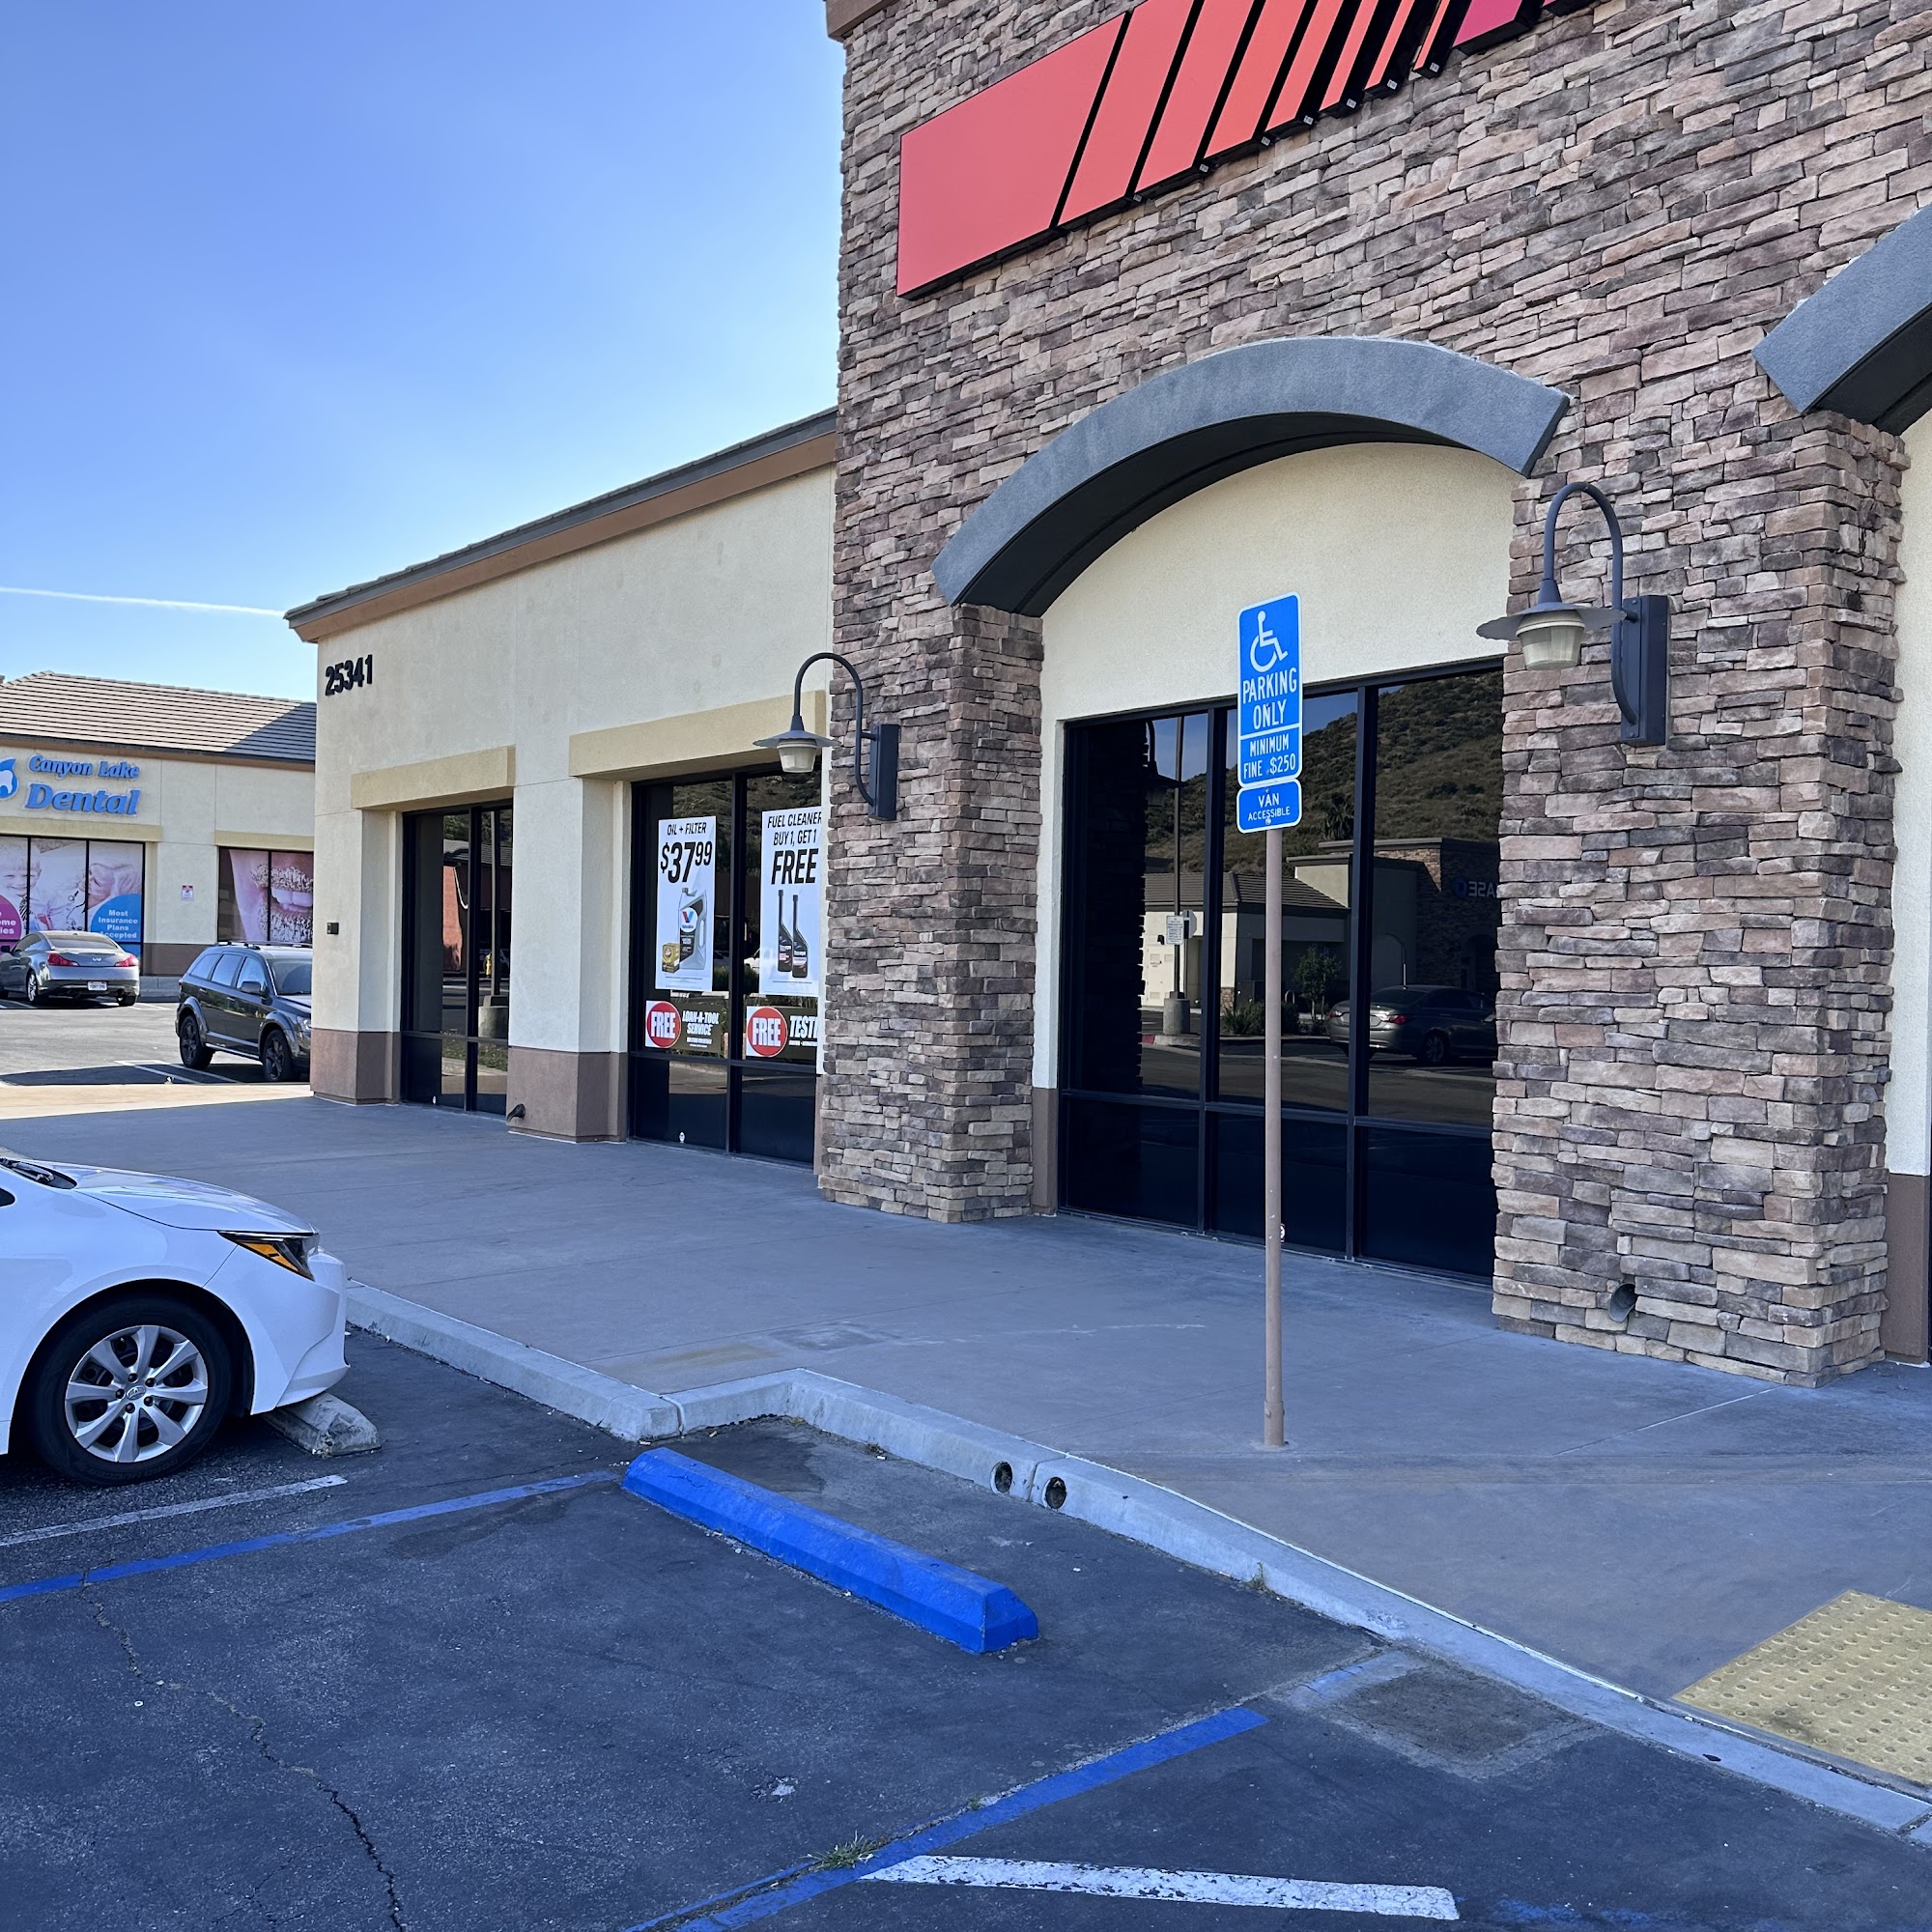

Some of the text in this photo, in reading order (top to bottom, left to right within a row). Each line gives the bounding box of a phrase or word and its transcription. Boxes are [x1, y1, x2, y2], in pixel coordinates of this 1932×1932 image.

[326, 654, 373, 696] 25341
[1242, 667, 1297, 704] PARKING
[1253, 698, 1287, 730] ONLY
[1249, 733, 1290, 757] MINIMUM
[28, 753, 141, 780] Canyon Lake
[1243, 753, 1296, 780] FINE $250
[24, 782, 140, 815] Dental
[1258, 792, 1280, 809] VAN
[767, 814, 785, 829] FUEL
[1247, 806, 1291, 821] ACCESSIBLE
[667, 823, 677, 836] OIL
[685, 822, 707, 835] FILTER
[773, 831, 789, 846] BUY
[797, 829, 812, 844] GET
[812, 828, 817, 843] 1
[771, 848, 819, 885] FREE
[650, 1010, 676, 1039] FREE
[687, 1022, 714, 1037] SERVICE
[752, 1017, 781, 1047] FREE
